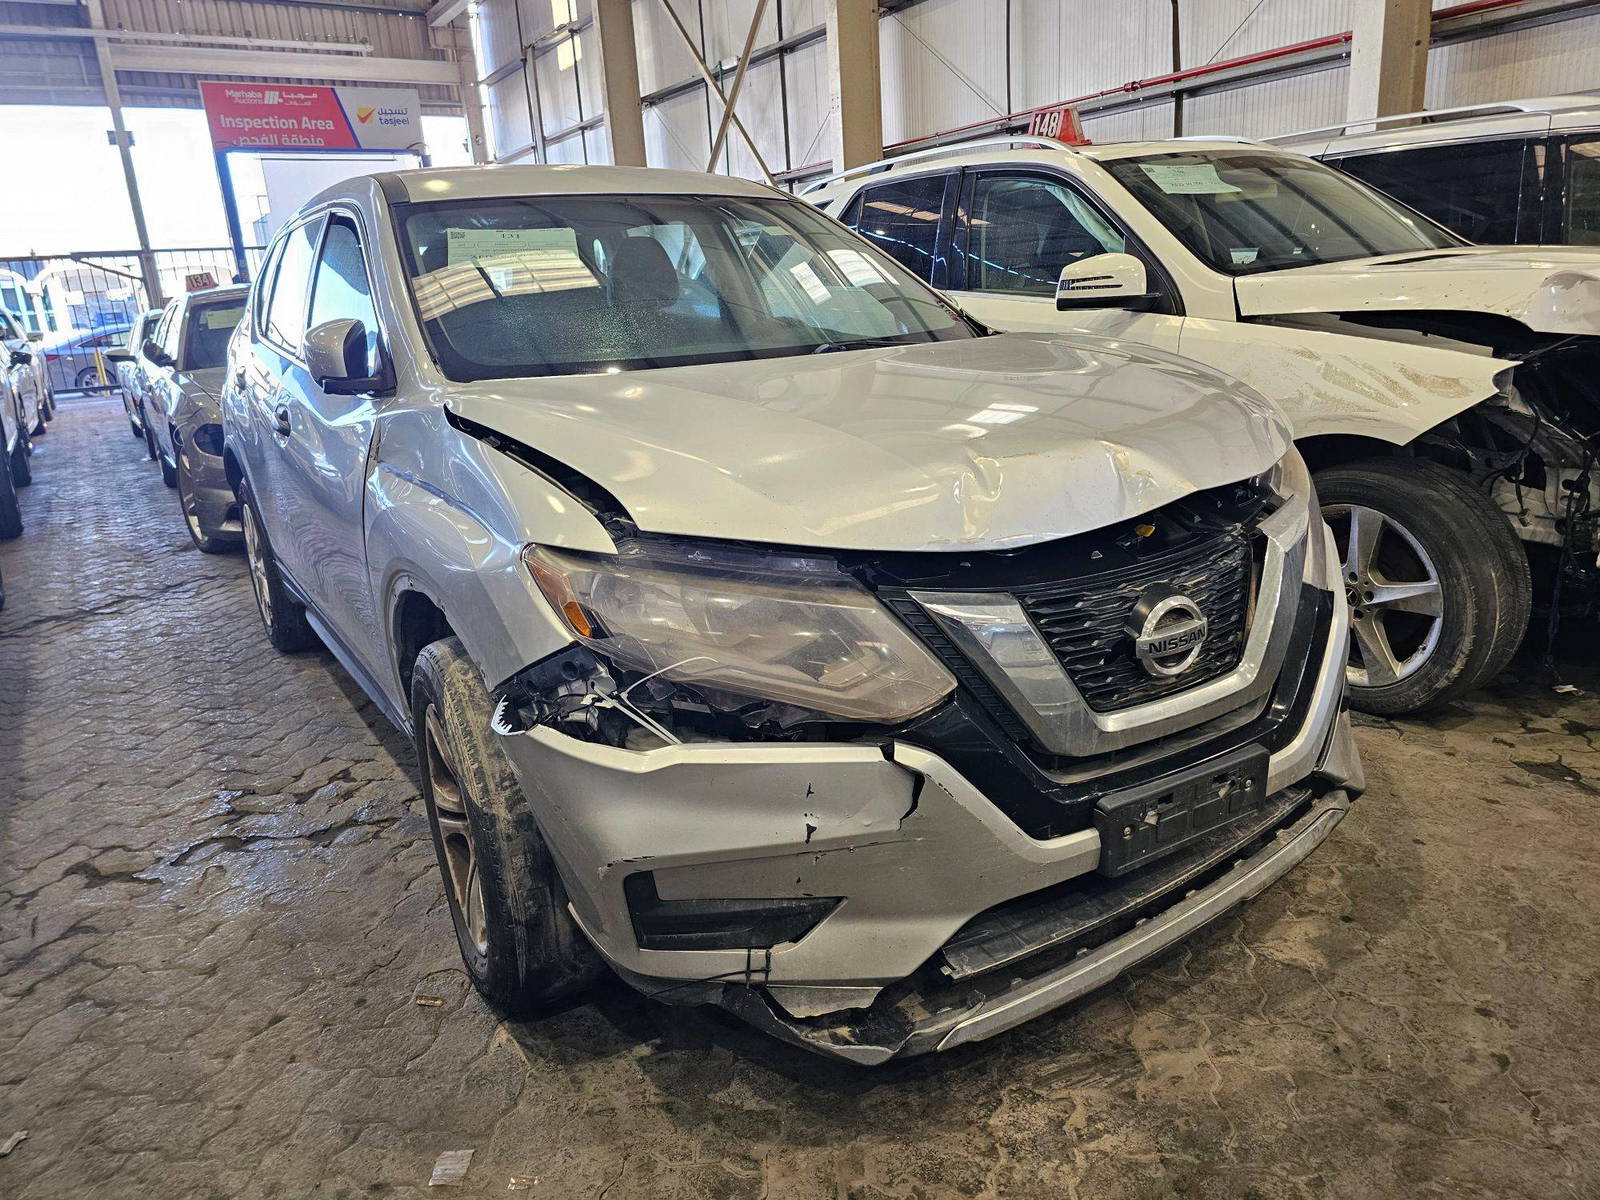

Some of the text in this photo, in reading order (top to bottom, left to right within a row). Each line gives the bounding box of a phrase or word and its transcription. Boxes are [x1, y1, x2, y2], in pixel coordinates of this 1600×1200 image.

[377, 107, 408, 117] تسجيل
[220, 114, 335, 131] Inspection Area
[379, 117, 410, 126] tasjeel
[1033, 112, 1059, 137] 148
[282, 134, 325, 146] منطقة
[190, 273, 209, 288] 134
[1148, 625, 1206, 654] NISSAN
